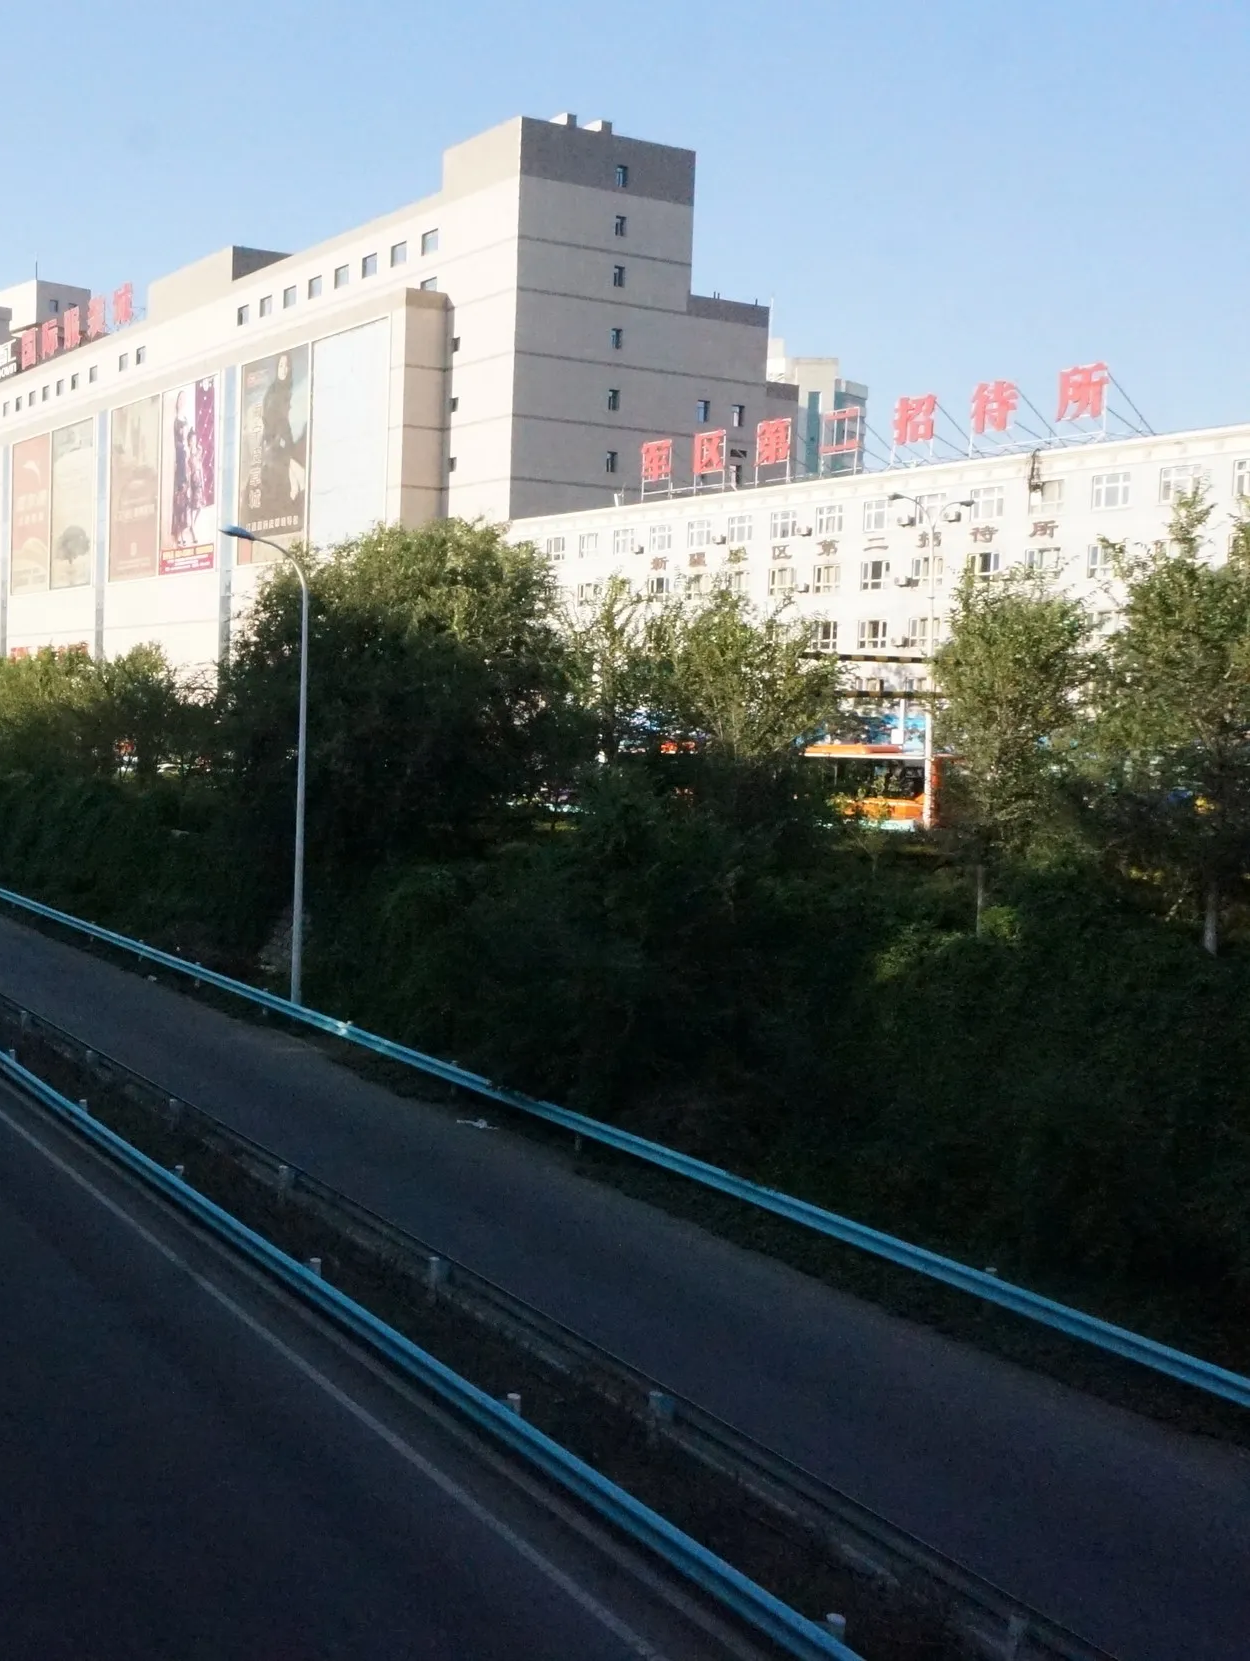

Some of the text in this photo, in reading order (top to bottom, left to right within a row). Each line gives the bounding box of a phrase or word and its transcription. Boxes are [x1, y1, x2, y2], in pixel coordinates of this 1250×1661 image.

[641, 362, 1109, 480] 军区第二招待所
